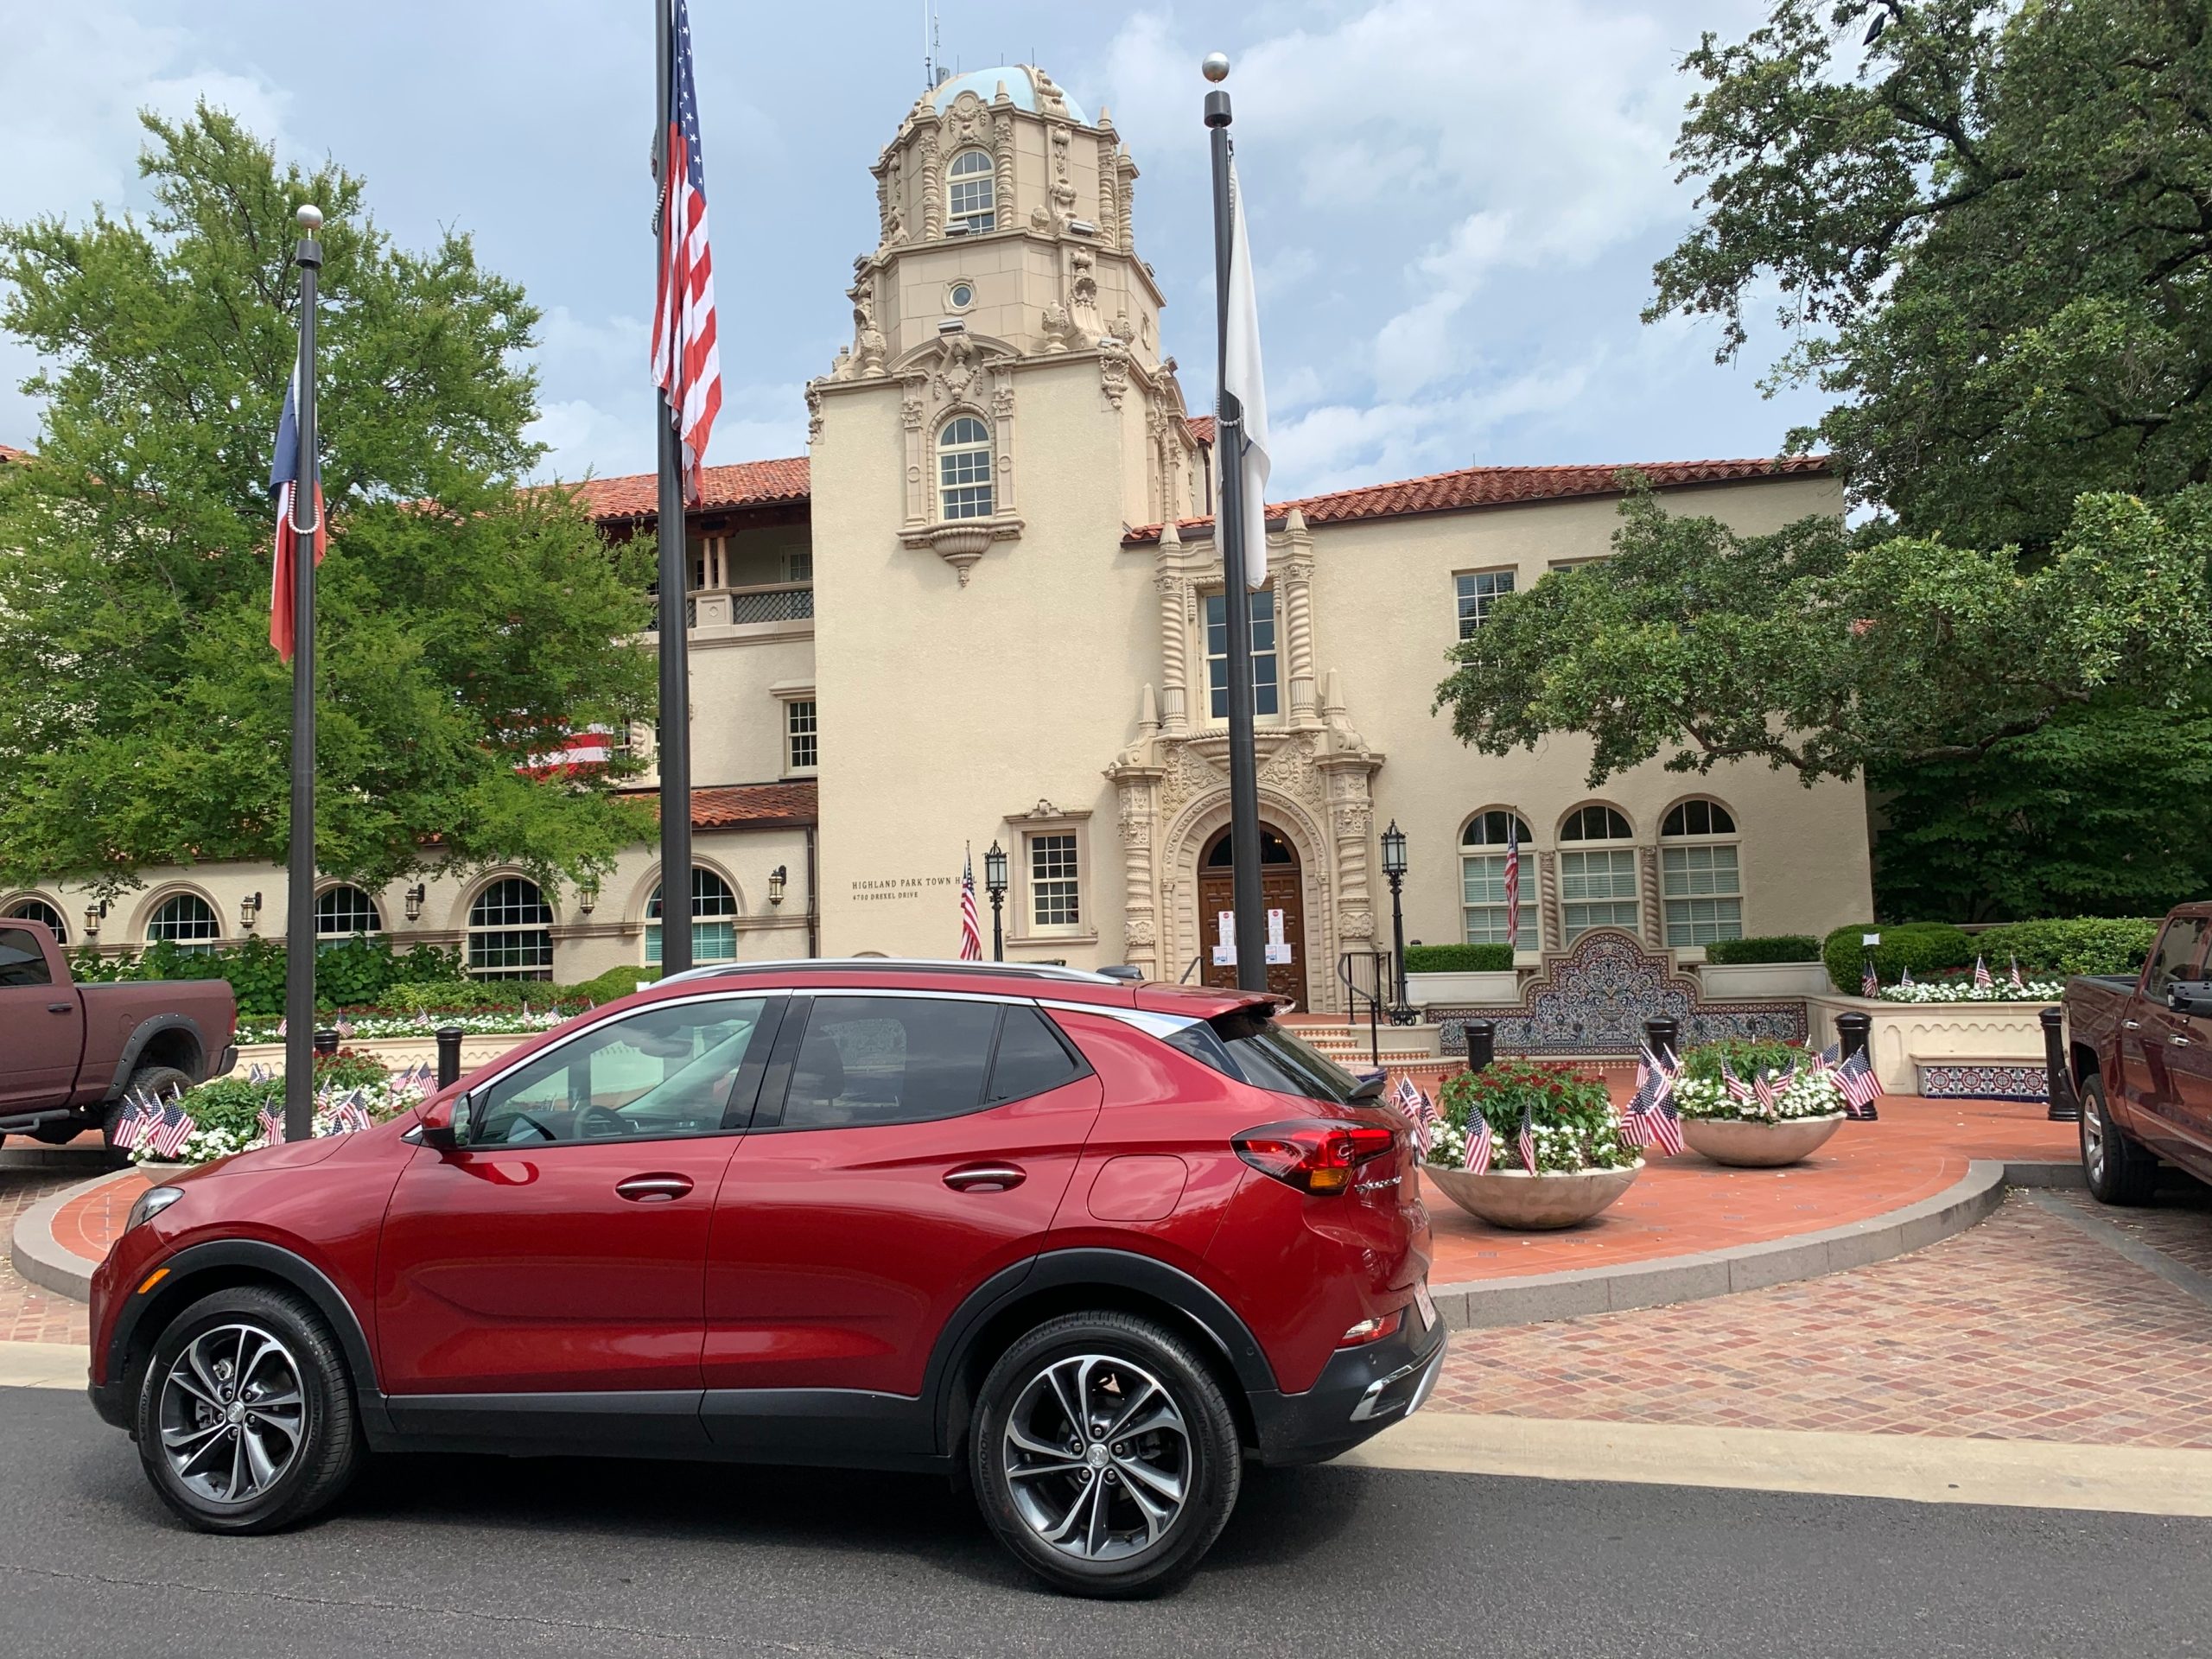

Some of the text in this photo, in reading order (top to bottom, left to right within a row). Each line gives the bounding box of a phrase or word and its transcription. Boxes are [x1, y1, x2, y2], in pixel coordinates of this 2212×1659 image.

[852, 875, 977, 890] HIGHLAND PARK TOWN HL
[898, 891, 918, 899] DRIVE
